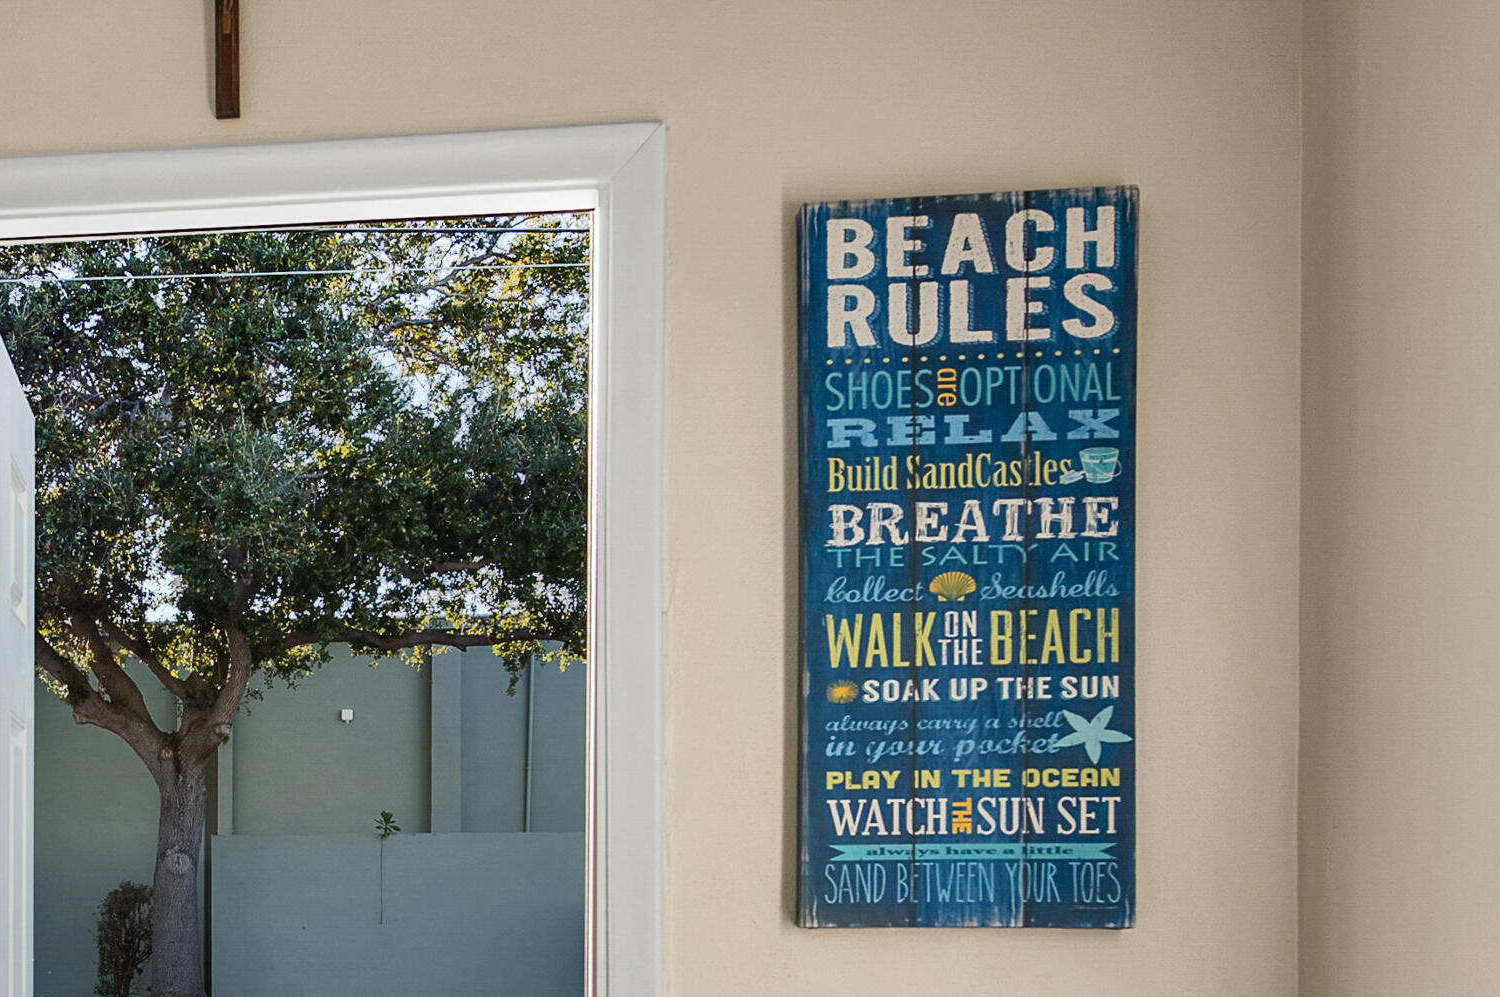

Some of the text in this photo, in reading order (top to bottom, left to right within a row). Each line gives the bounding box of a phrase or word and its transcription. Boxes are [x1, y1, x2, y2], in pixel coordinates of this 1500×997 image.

[826, 206, 1117, 279] BEACH
[826, 273, 1117, 348] RULES
[825, 362, 1121, 411] SHOES are OPTONAL
[827, 408, 1120, 448] RELAX
[827, 456, 898, 492] Build
[824, 496, 1119, 547] BREATHE
[827, 542, 1120, 568] THE SALTY AIR
[824, 569, 1120, 603] Collect Seashells
[826, 607, 1119, 668] WALK ON THE BEACH
[862, 675, 1119, 703] SOAK UP THE SUN
[825, 711, 1064, 735] always carry a shell
[825, 730, 1060, 764] in your pocket
[825, 767, 1120, 790] PLAY IN THE OCEAN
[826, 796, 1121, 836] WATCH THE SUN SET
[866, 846, 940, 858] always
[945, 846, 998, 856] have
[1021, 846, 1074, 855] little
[824, 862, 1121, 904] SAND BETWEEN YOUR TOES
